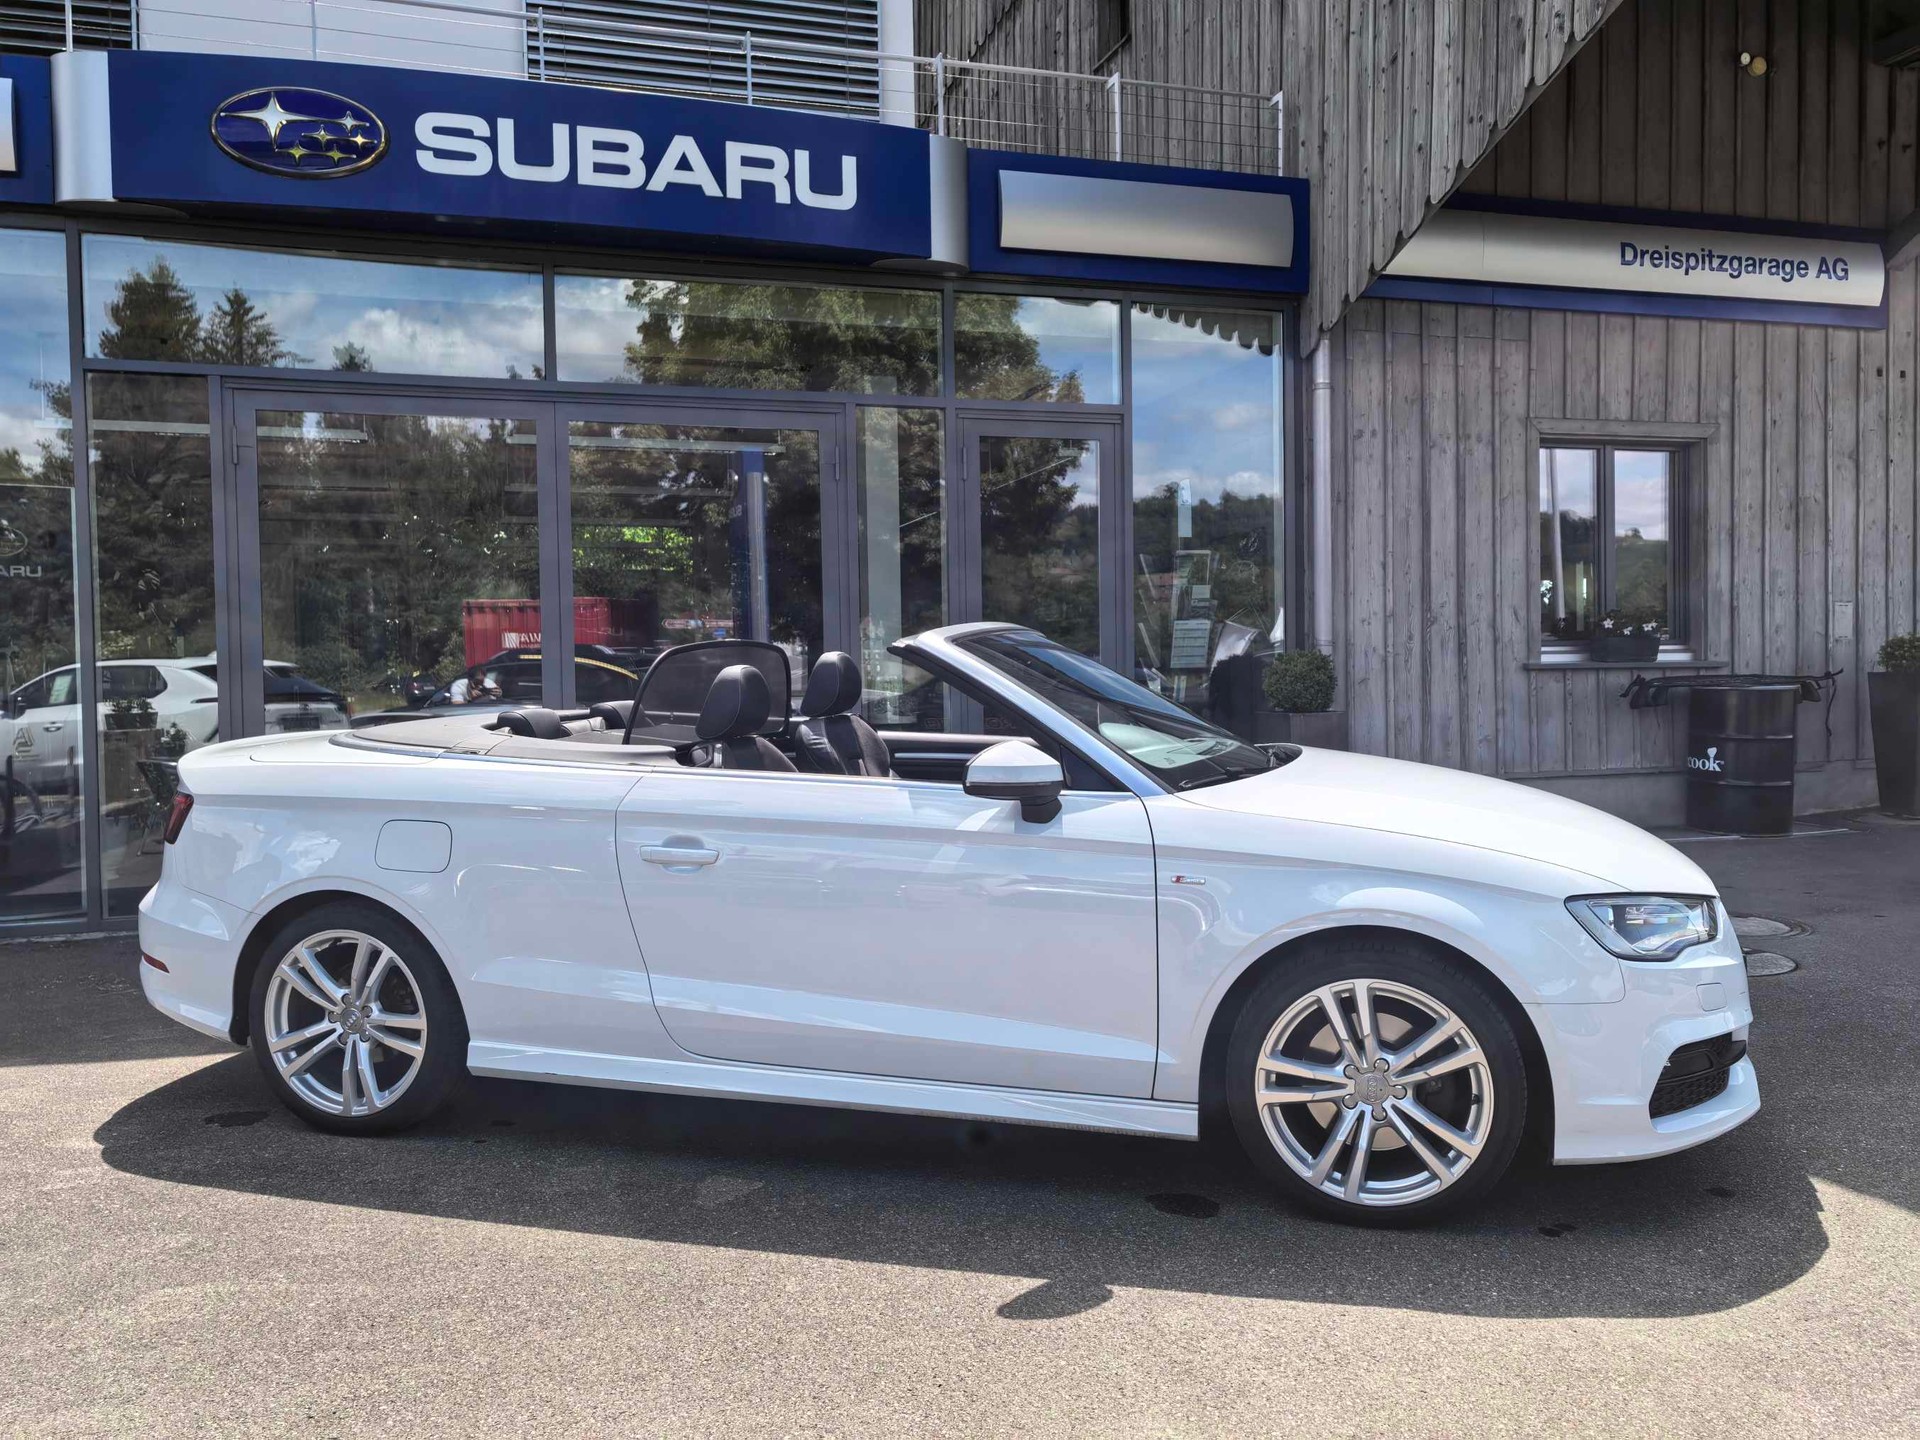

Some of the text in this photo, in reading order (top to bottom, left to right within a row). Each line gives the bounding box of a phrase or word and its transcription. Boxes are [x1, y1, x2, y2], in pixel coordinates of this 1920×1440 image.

[414, 111, 857, 211] SUBARU
[1620, 241, 1849, 283] Dreispitzgarage AG
